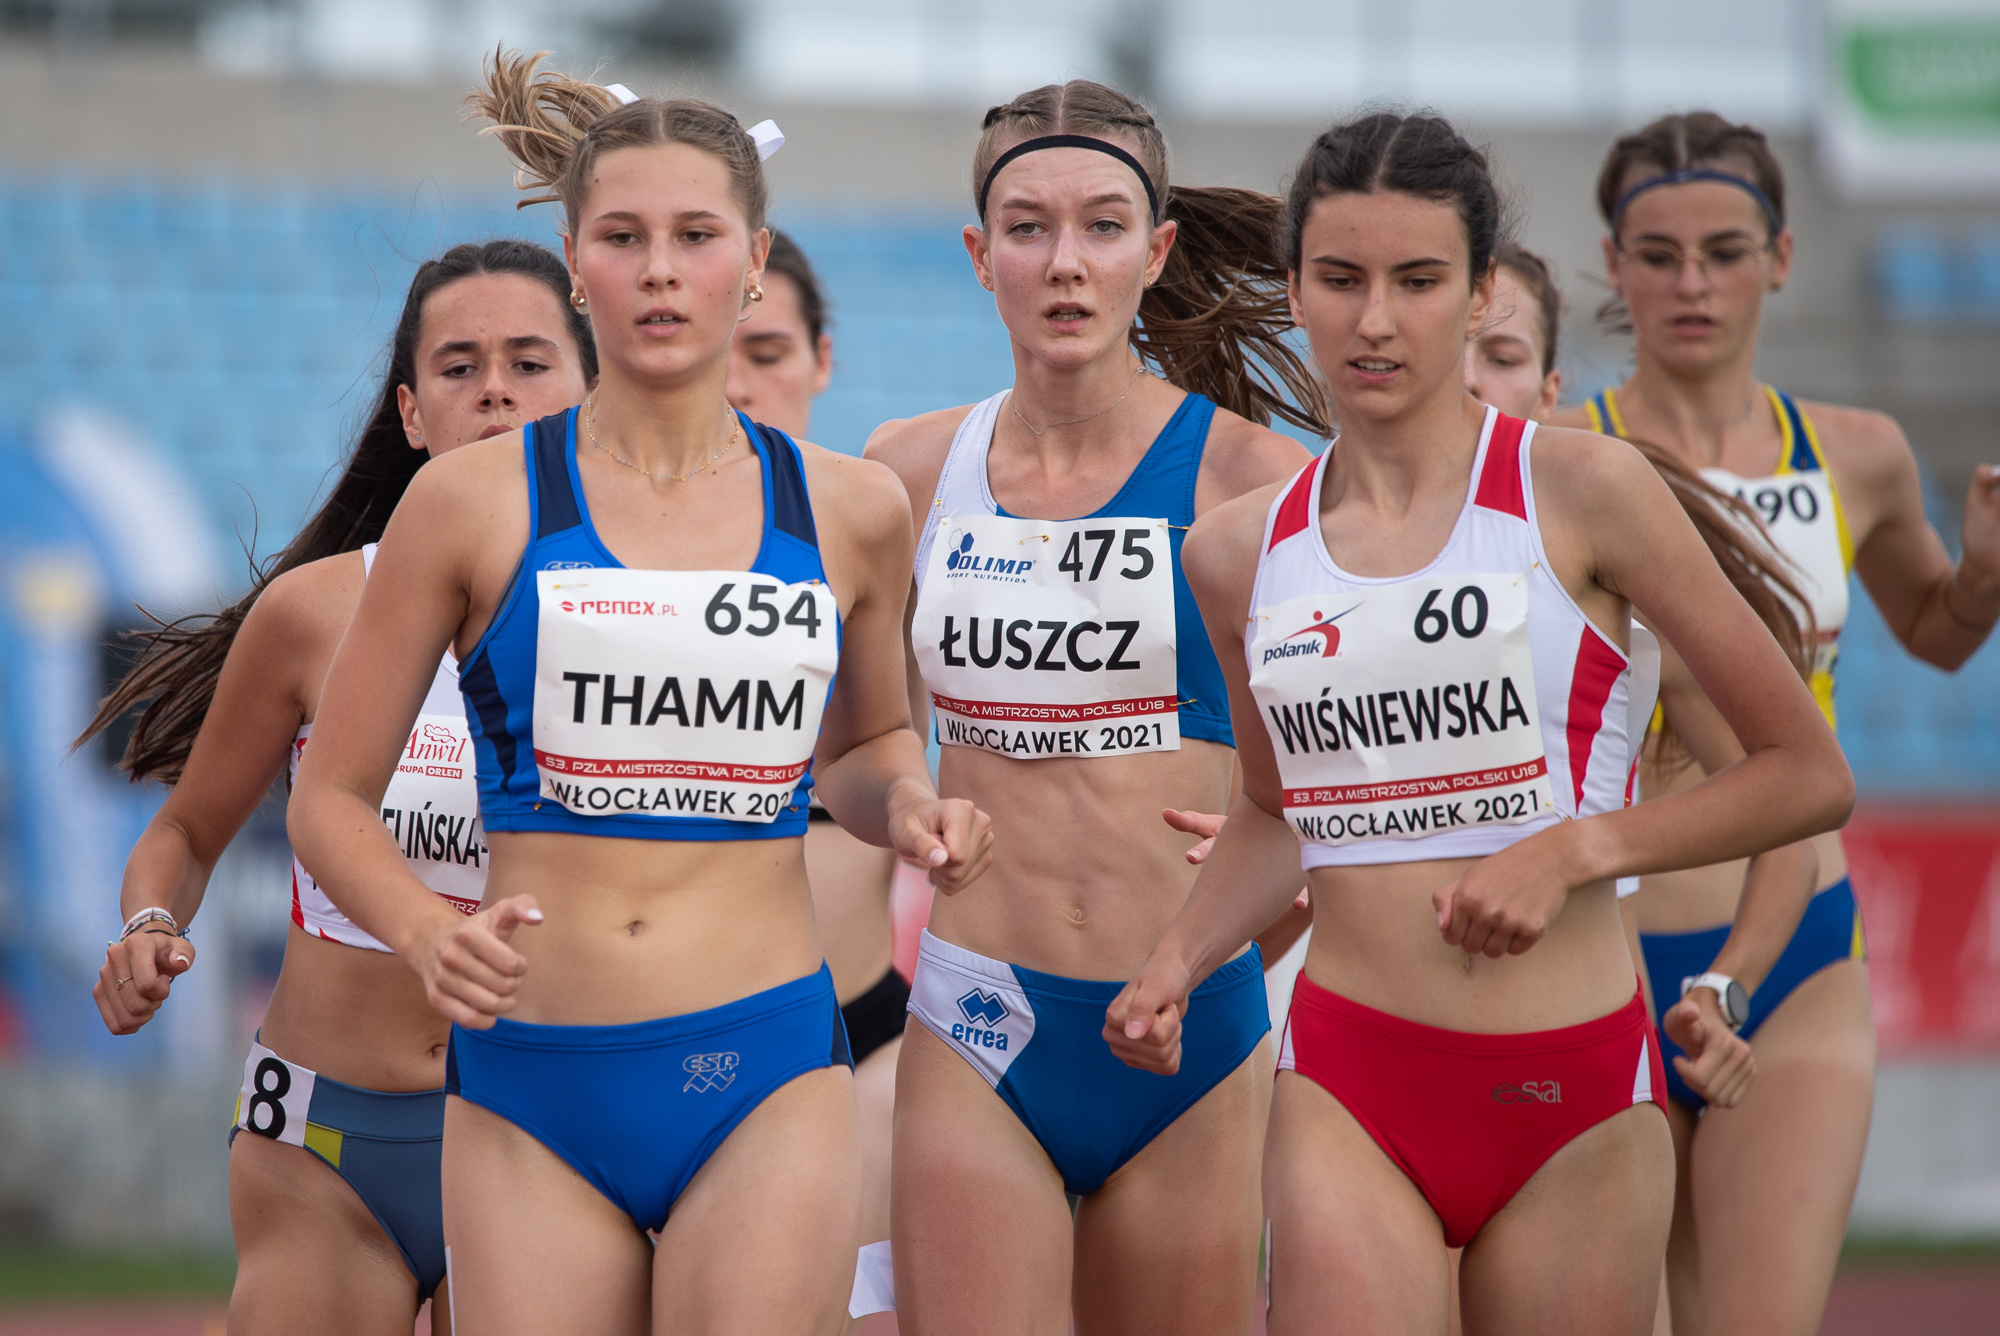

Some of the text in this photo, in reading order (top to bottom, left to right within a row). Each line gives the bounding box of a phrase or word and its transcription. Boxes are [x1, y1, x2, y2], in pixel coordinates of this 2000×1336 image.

[1735, 484, 1818, 523] 90
[958, 555, 1033, 575] OLIMP
[1058, 529, 1154, 582] 475
[973, 573, 1027, 584] NUTRITION
[704, 583, 821, 638] 654
[1414, 586, 1488, 643] 60
[939, 615, 1140, 672] ŁUSZCZ
[1263, 639, 1321, 666] polanik
[563, 671, 805, 731] THAMM
[953, 702, 979, 715] PZLA
[981, 705, 1080, 719] MISTRZOSTWA
[1083, 702, 1135, 717] POLSKI
[1138, 700, 1165, 711] U18
[1268, 677, 1530, 755] WIŚNIEWSKA
[405, 728, 467, 763] Anwil
[946, 718, 1162, 753] WŁOCŁAWEK 2021
[427, 767, 461, 778] ORLEN
[545, 756, 569, 771] 53.
[572, 761, 613, 774] PZLA
[616, 763, 729, 778] MISTRZOSTWA
[732, 768, 786, 780] POLSKI
[1293, 763, 1538, 803] 53. PZLA MISTRZOSTWA POLSKI U18
[549, 778, 795, 817] WŁOCŁAWEK 202
[1296, 789, 1538, 840] WŁOCŁAWEK 2021
[951, 1023, 1009, 1051] errea
[246, 1057, 291, 1140] 8
